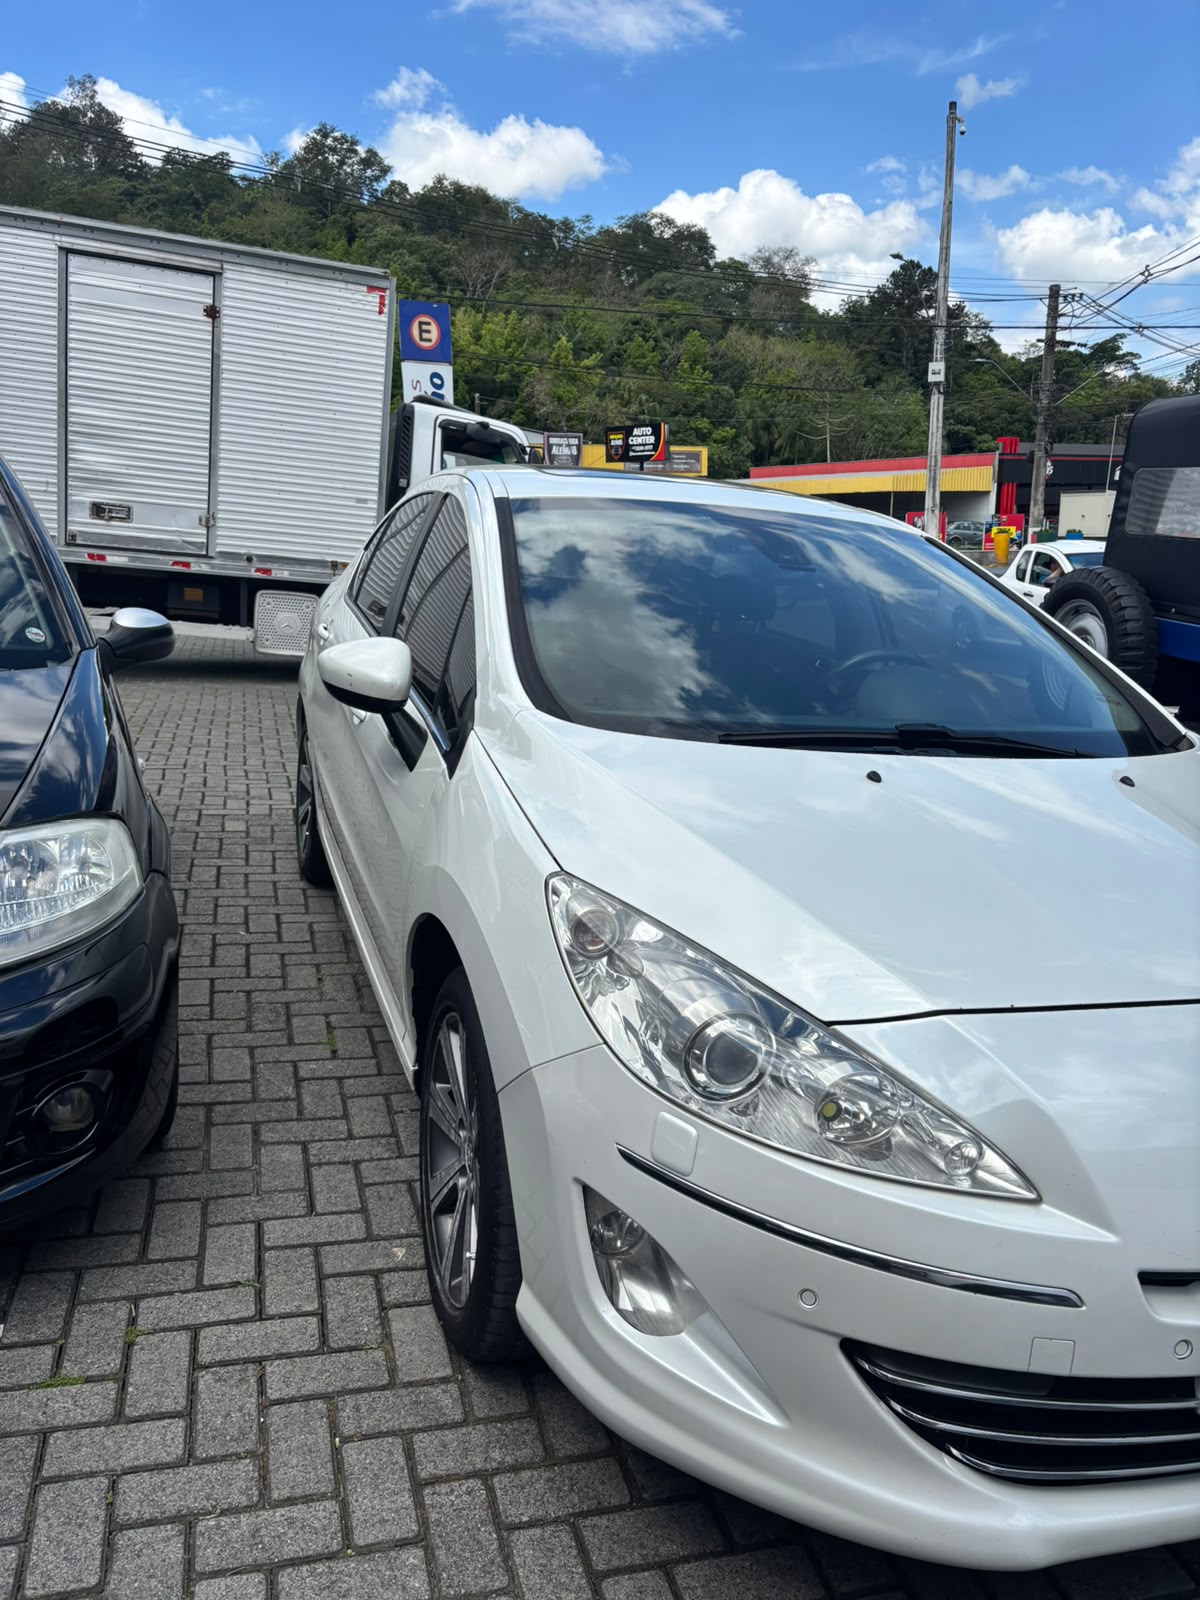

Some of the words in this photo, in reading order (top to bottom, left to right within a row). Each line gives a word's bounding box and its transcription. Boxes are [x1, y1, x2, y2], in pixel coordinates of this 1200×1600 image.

[418, 321, 432, 342] E
[633, 427, 652, 436] AUTO
[629, 436, 655, 445] CENTER
